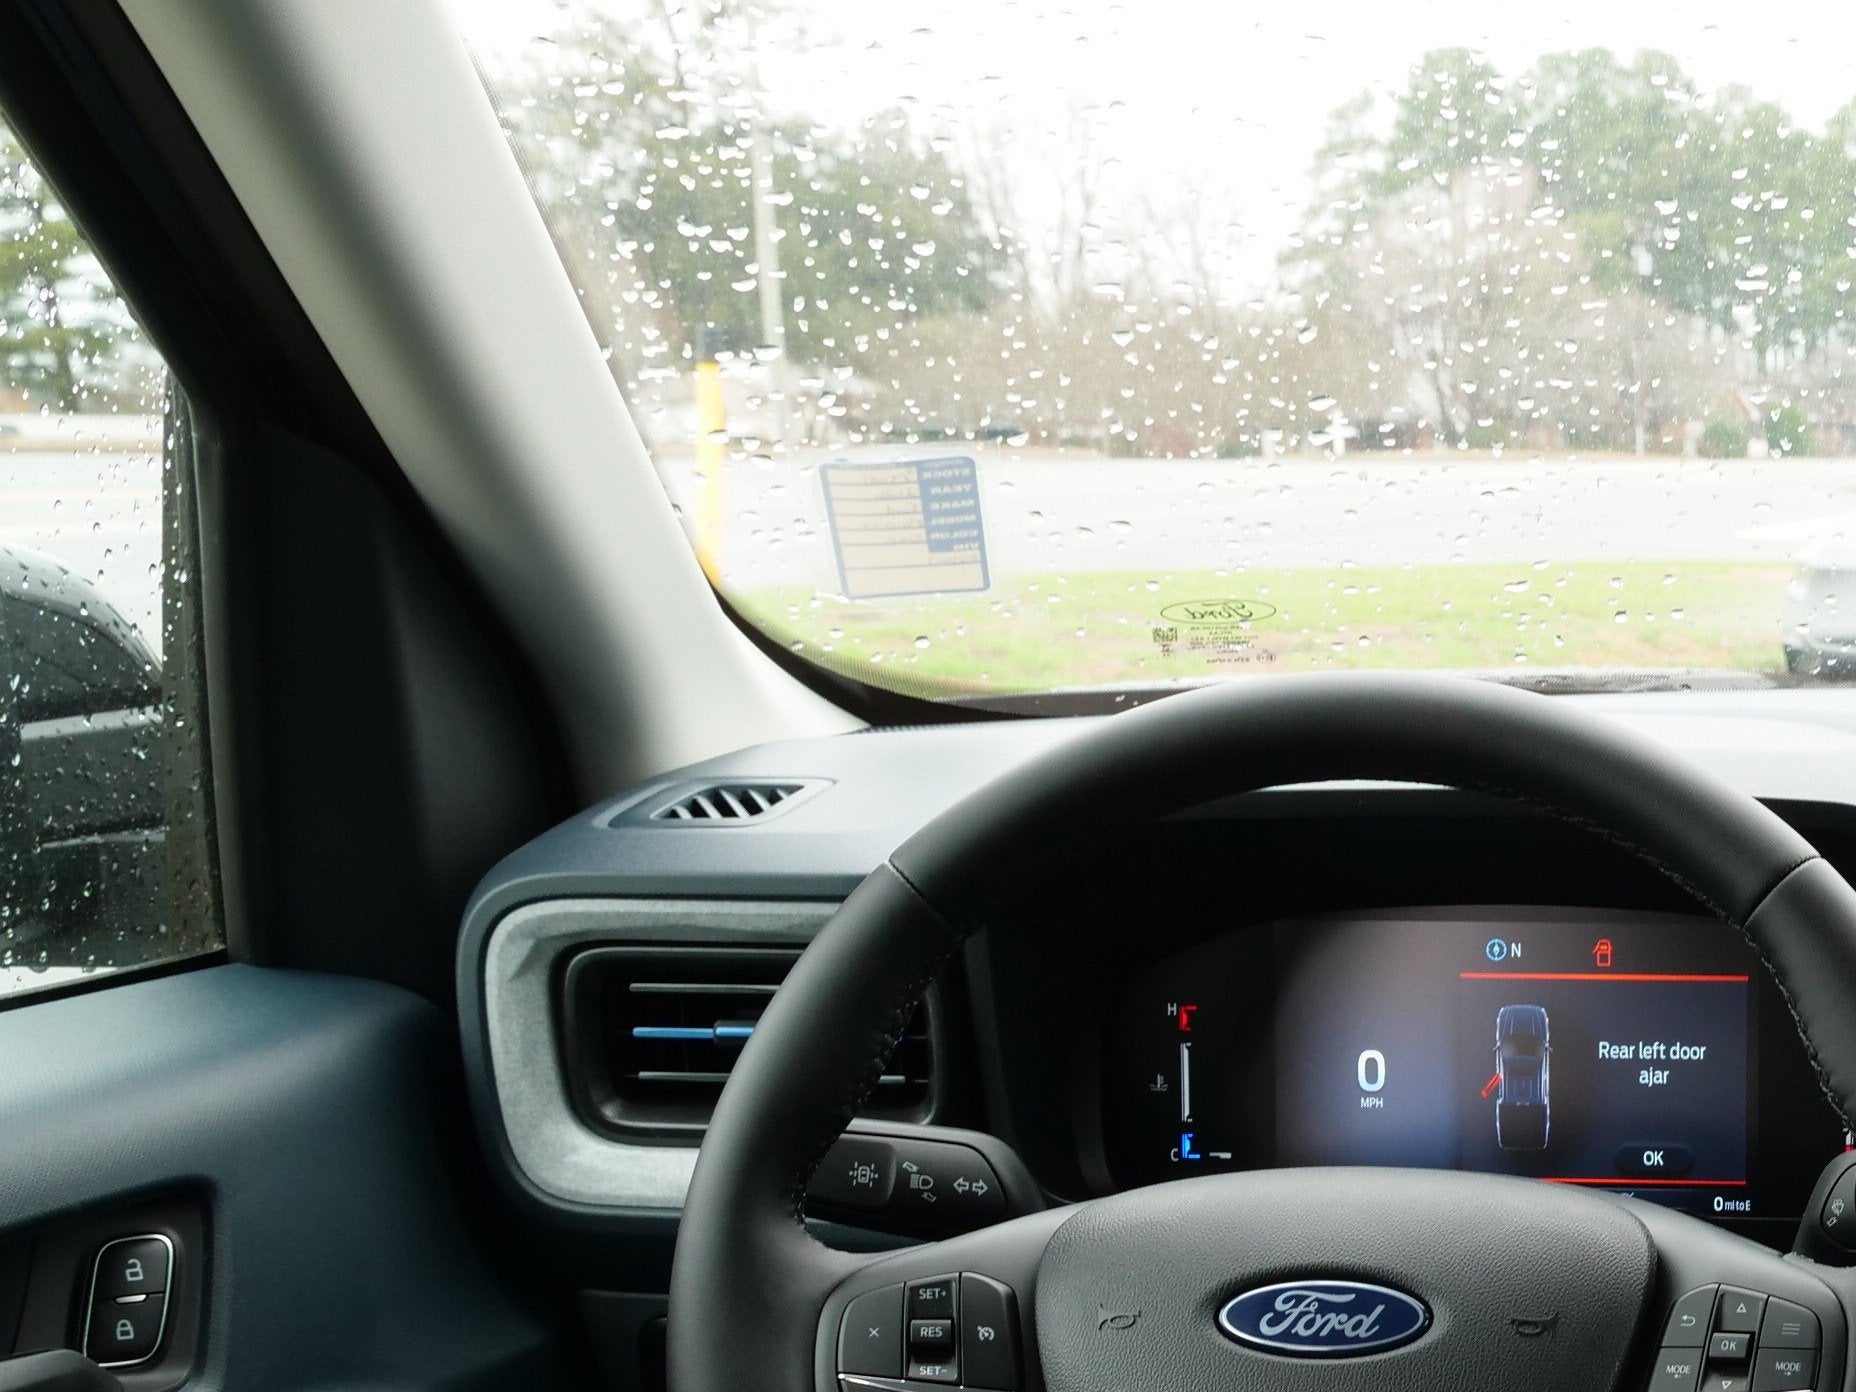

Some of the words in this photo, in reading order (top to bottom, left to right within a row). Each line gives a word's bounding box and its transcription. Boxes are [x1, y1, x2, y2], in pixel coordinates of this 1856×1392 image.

[1510, 942, 1522, 958] N
[1167, 1002, 1177, 1016] H
[1598, 1041, 1635, 1060] Rear
[1638, 1041, 1667, 1060] left
[1669, 1041, 1707, 1060] door
[1357, 1049, 1386, 1093] 0
[1638, 1066, 1670, 1088] ajar
[1359, 1096, 1384, 1110] MPH
[1643, 1150, 1664, 1167] OK
[1713, 1196, 1724, 1212] 0
[1258, 1288, 1386, 1339] Ford
[919, 1326, 943, 1338] RES
[1720, 1339, 1737, 1351] OK
[1665, 1363, 1691, 1375] MODE
[1774, 1361, 1802, 1372] MODE
